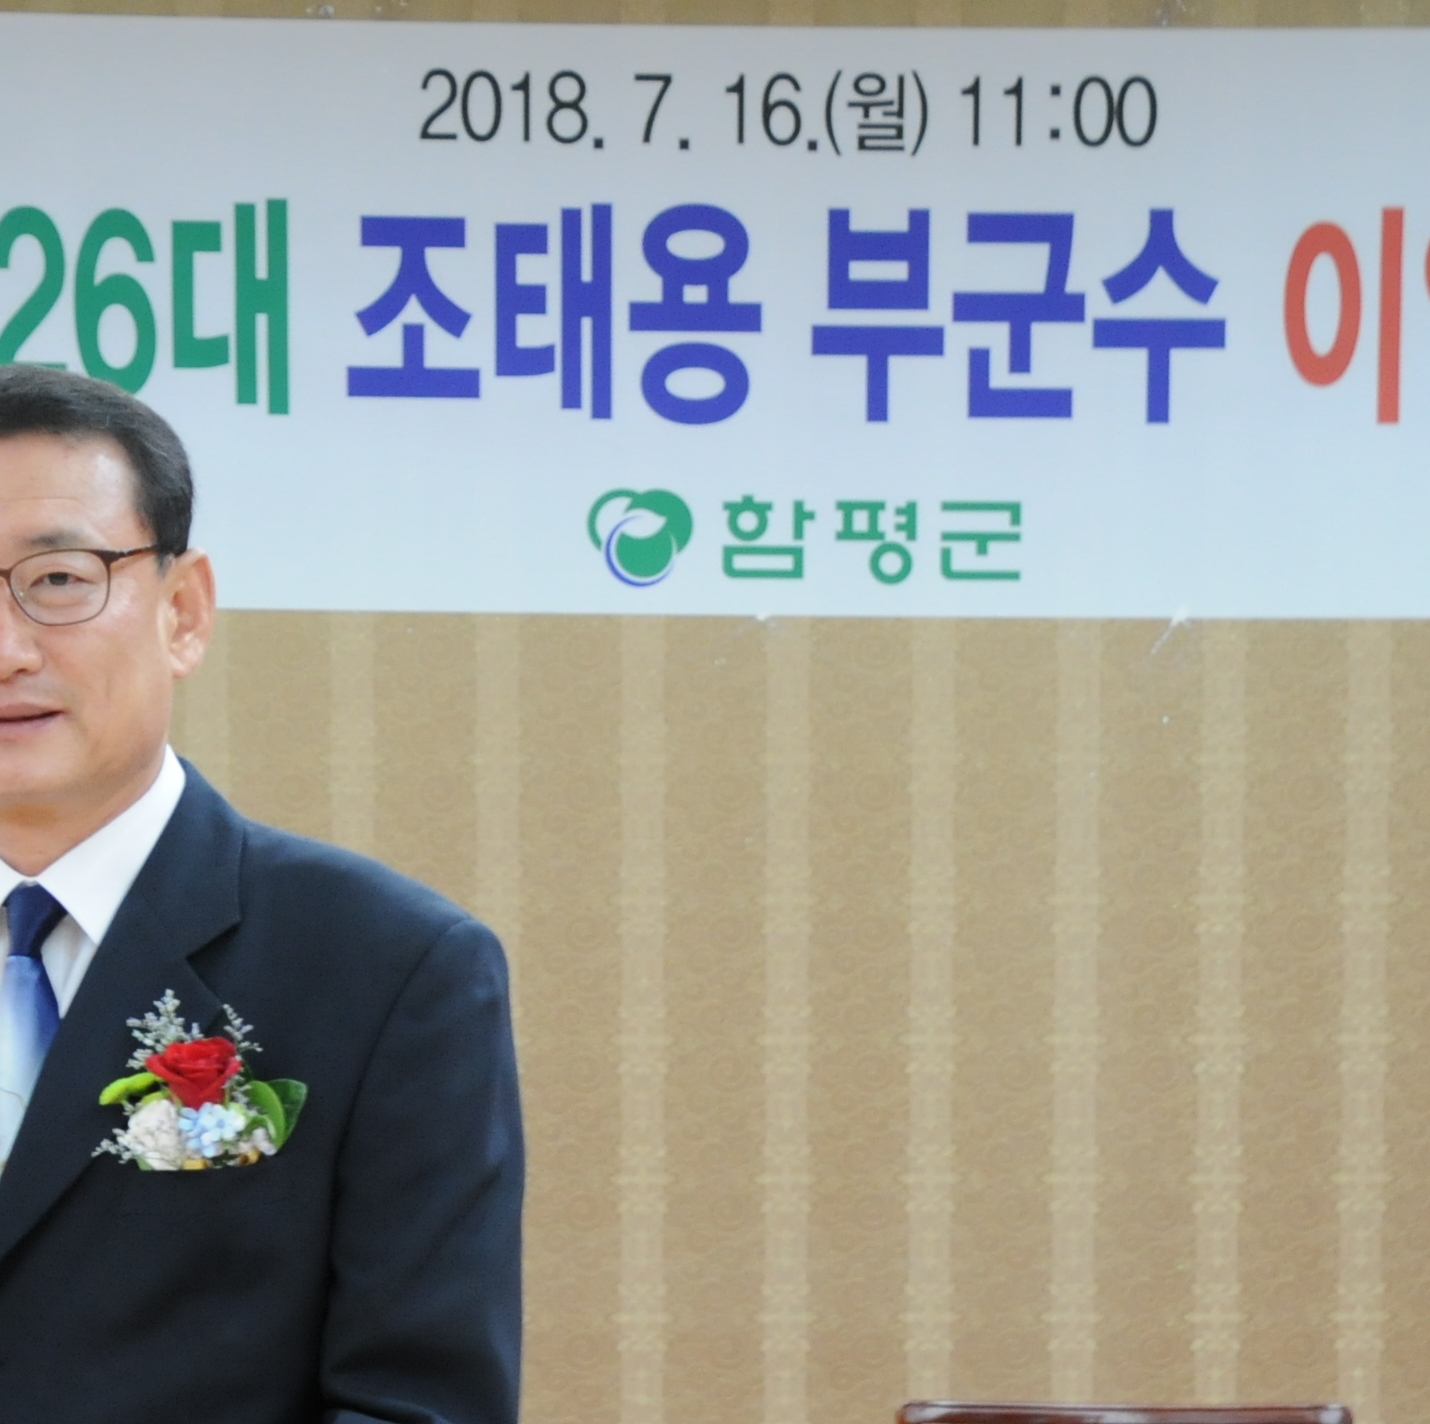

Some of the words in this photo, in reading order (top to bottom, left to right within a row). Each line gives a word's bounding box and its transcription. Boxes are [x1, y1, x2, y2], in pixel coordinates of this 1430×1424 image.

[419, 69, 605, 150] 2018.
[633, 74, 691, 151] 7.
[724, 71, 929, 156] 16.(월)
[960, 76, 1159, 148] 11:00
[345, 202, 765, 427] 조태용
[810, 207, 1228, 427] 부군수
[720, 494, 1023, 586] 함평군
